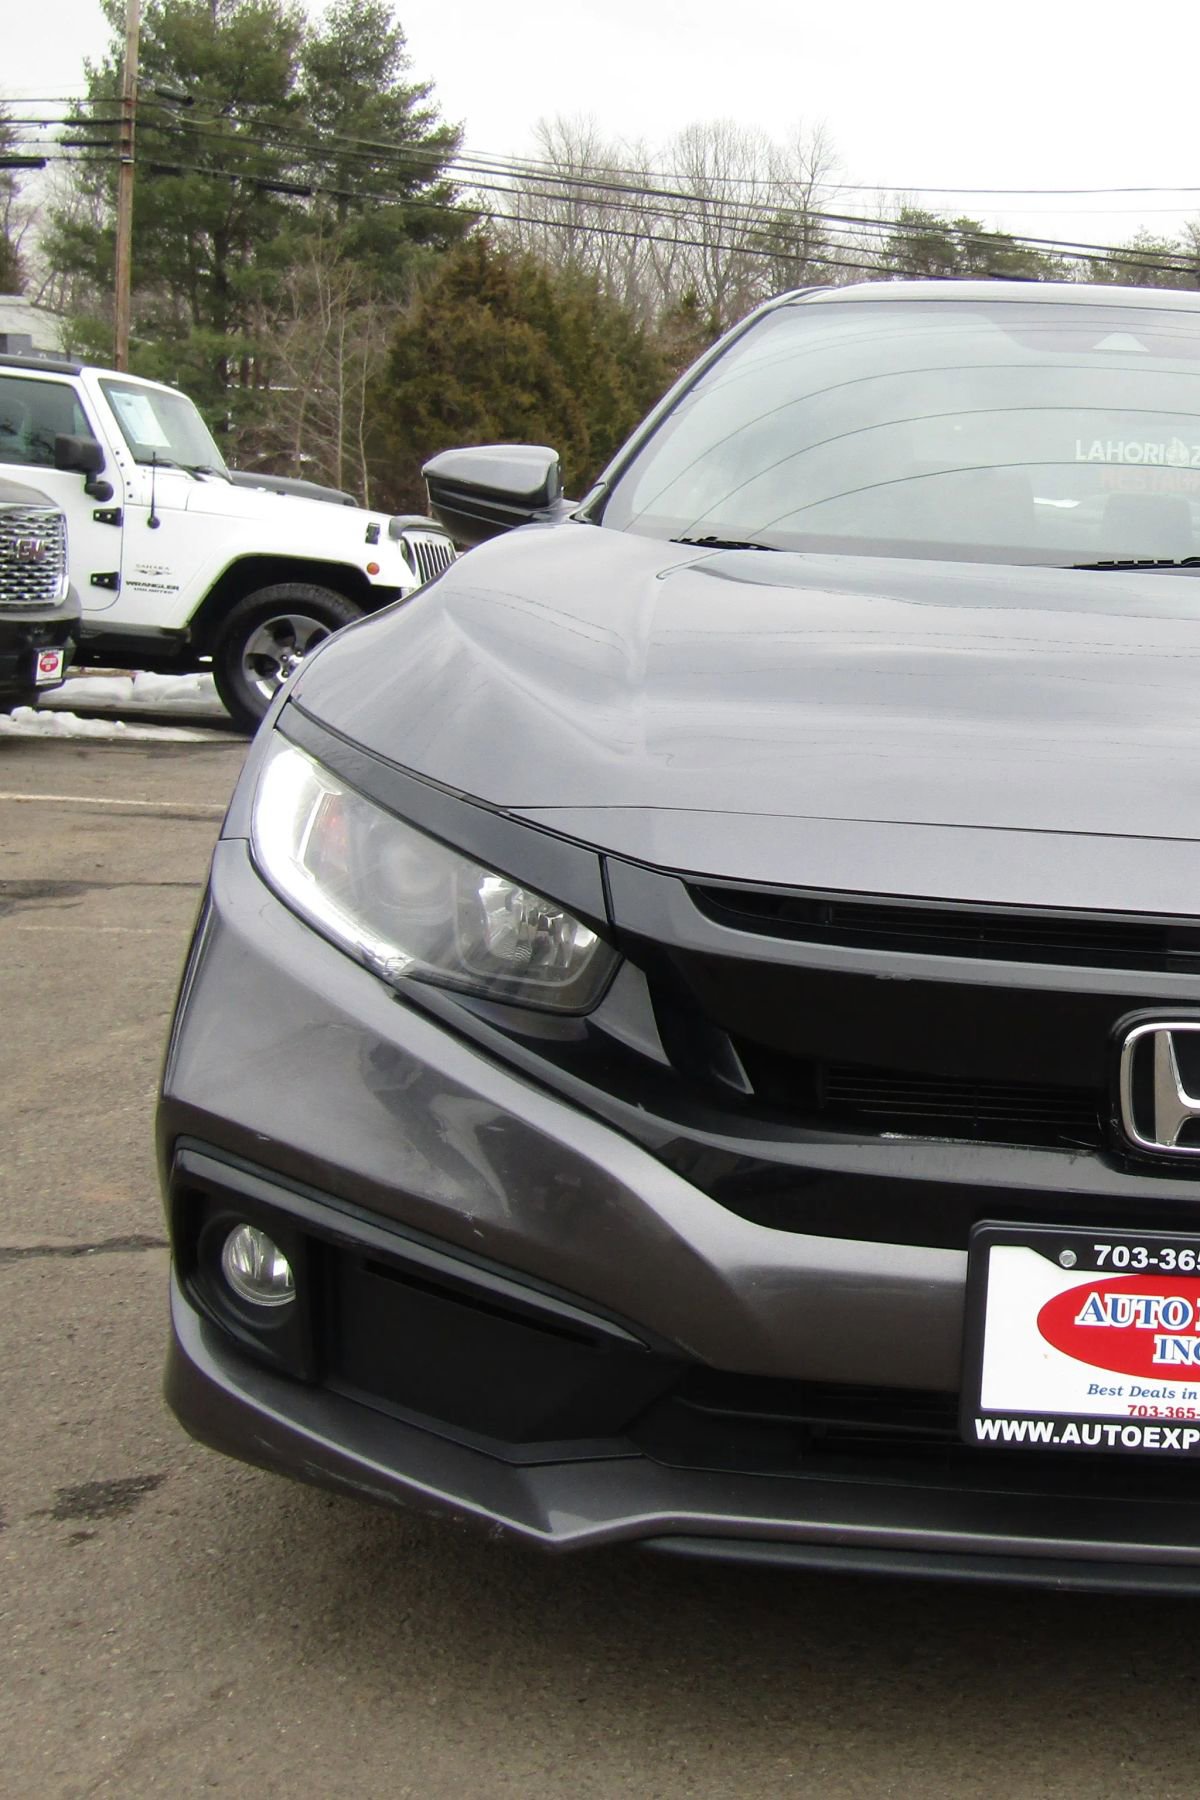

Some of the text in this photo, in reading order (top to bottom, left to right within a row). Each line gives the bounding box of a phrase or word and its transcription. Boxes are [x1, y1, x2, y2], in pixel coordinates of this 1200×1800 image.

[1075, 440, 1164, 465] LAHORI
[1076, 1293, 1192, 1330] AUTO
[1087, 1384, 1123, 1398] Best
[1129, 1386, 1176, 1400] Deals
[1182, 1388, 1198, 1400] in
